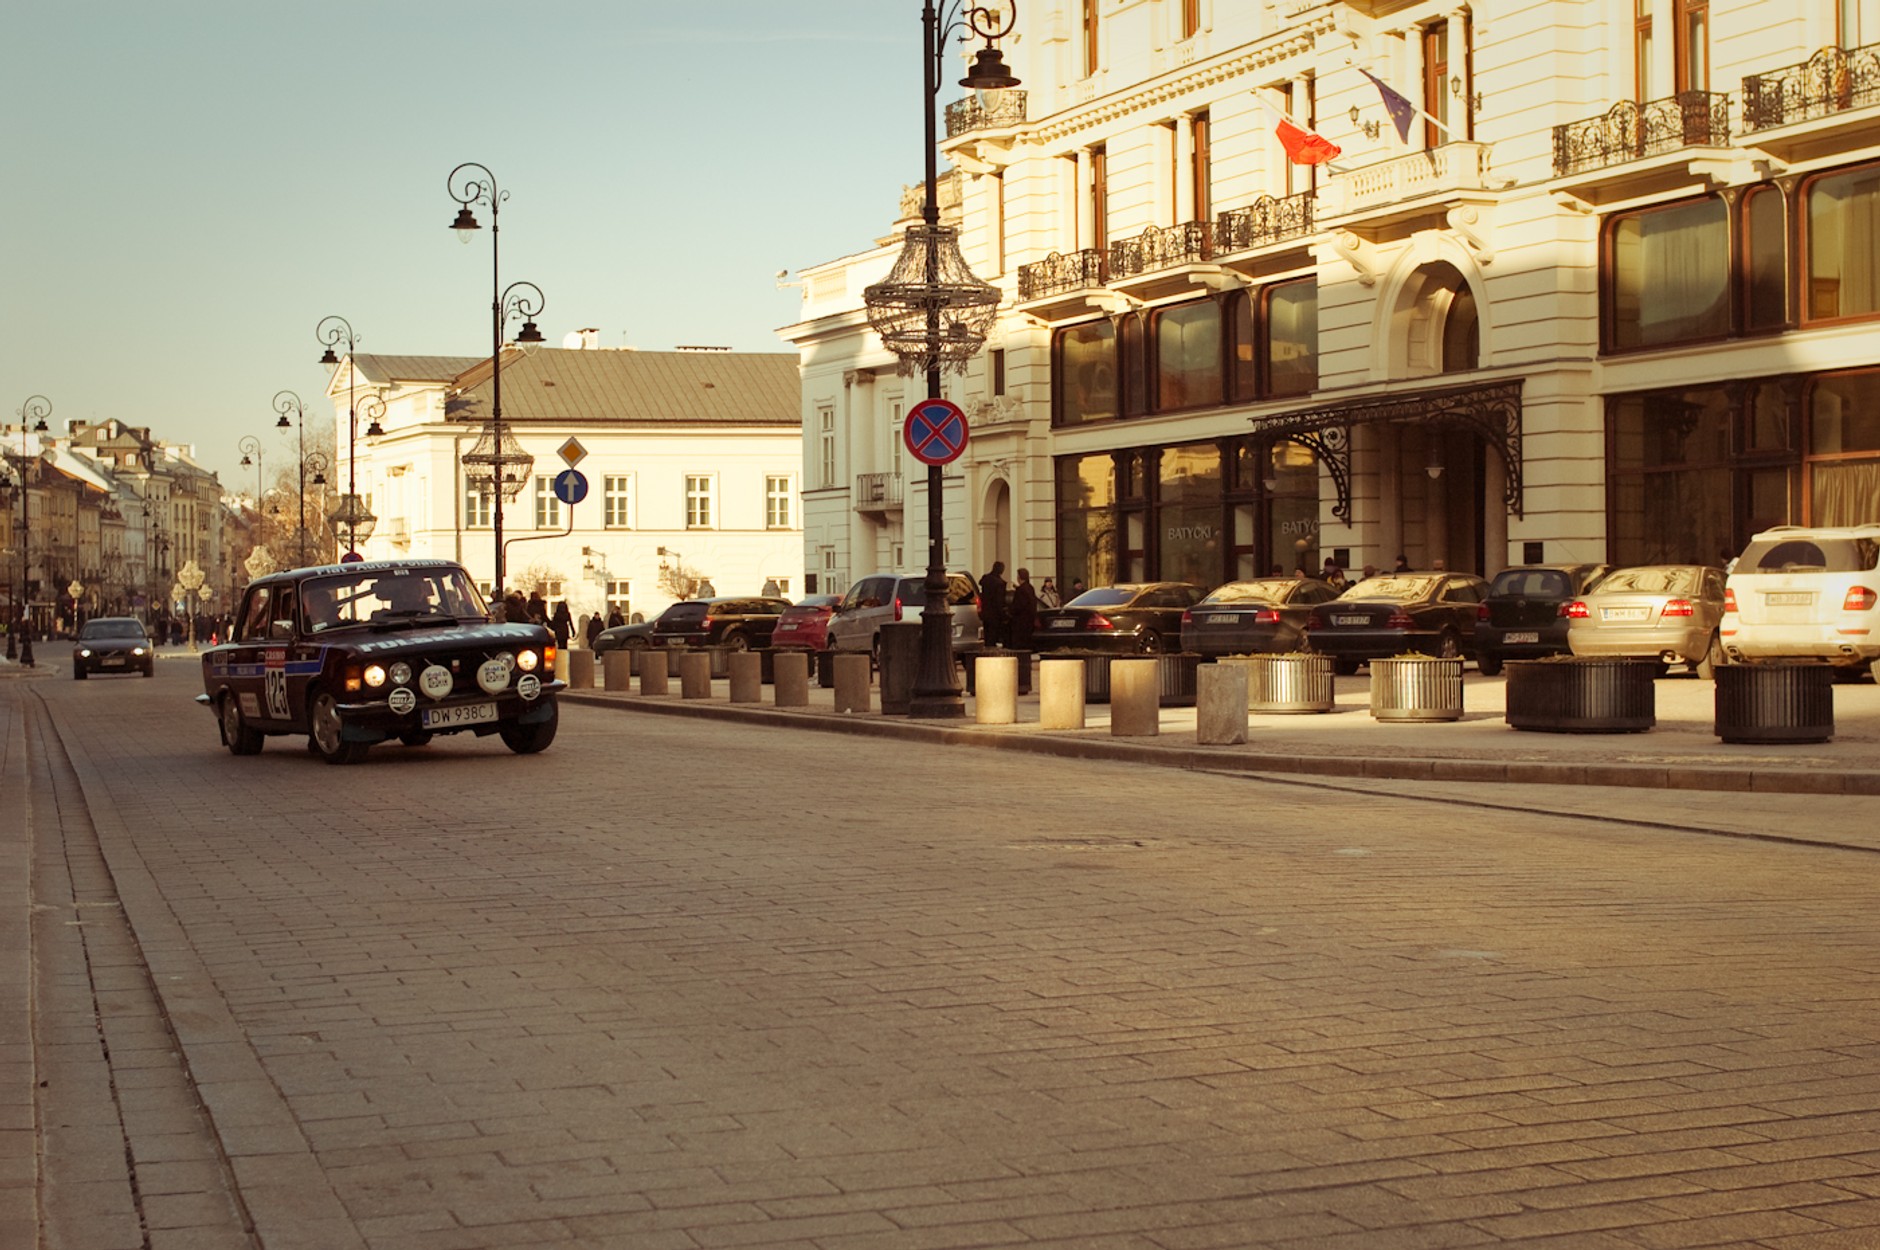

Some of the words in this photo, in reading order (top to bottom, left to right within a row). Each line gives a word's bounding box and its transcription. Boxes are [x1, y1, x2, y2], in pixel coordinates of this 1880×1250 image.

[1168, 527, 1212, 540] BATYCKI
[315, 567, 348, 576] Fiat
[356, 561, 391, 571] Auto
[397, 559, 448, 567] Poland
[358, 633, 465, 652] POLSKI
[471, 628, 535, 639] FIAT
[265, 670, 288, 715] 125
[430, 709, 450, 725] DW
[454, 705, 495, 721] 938CJ
